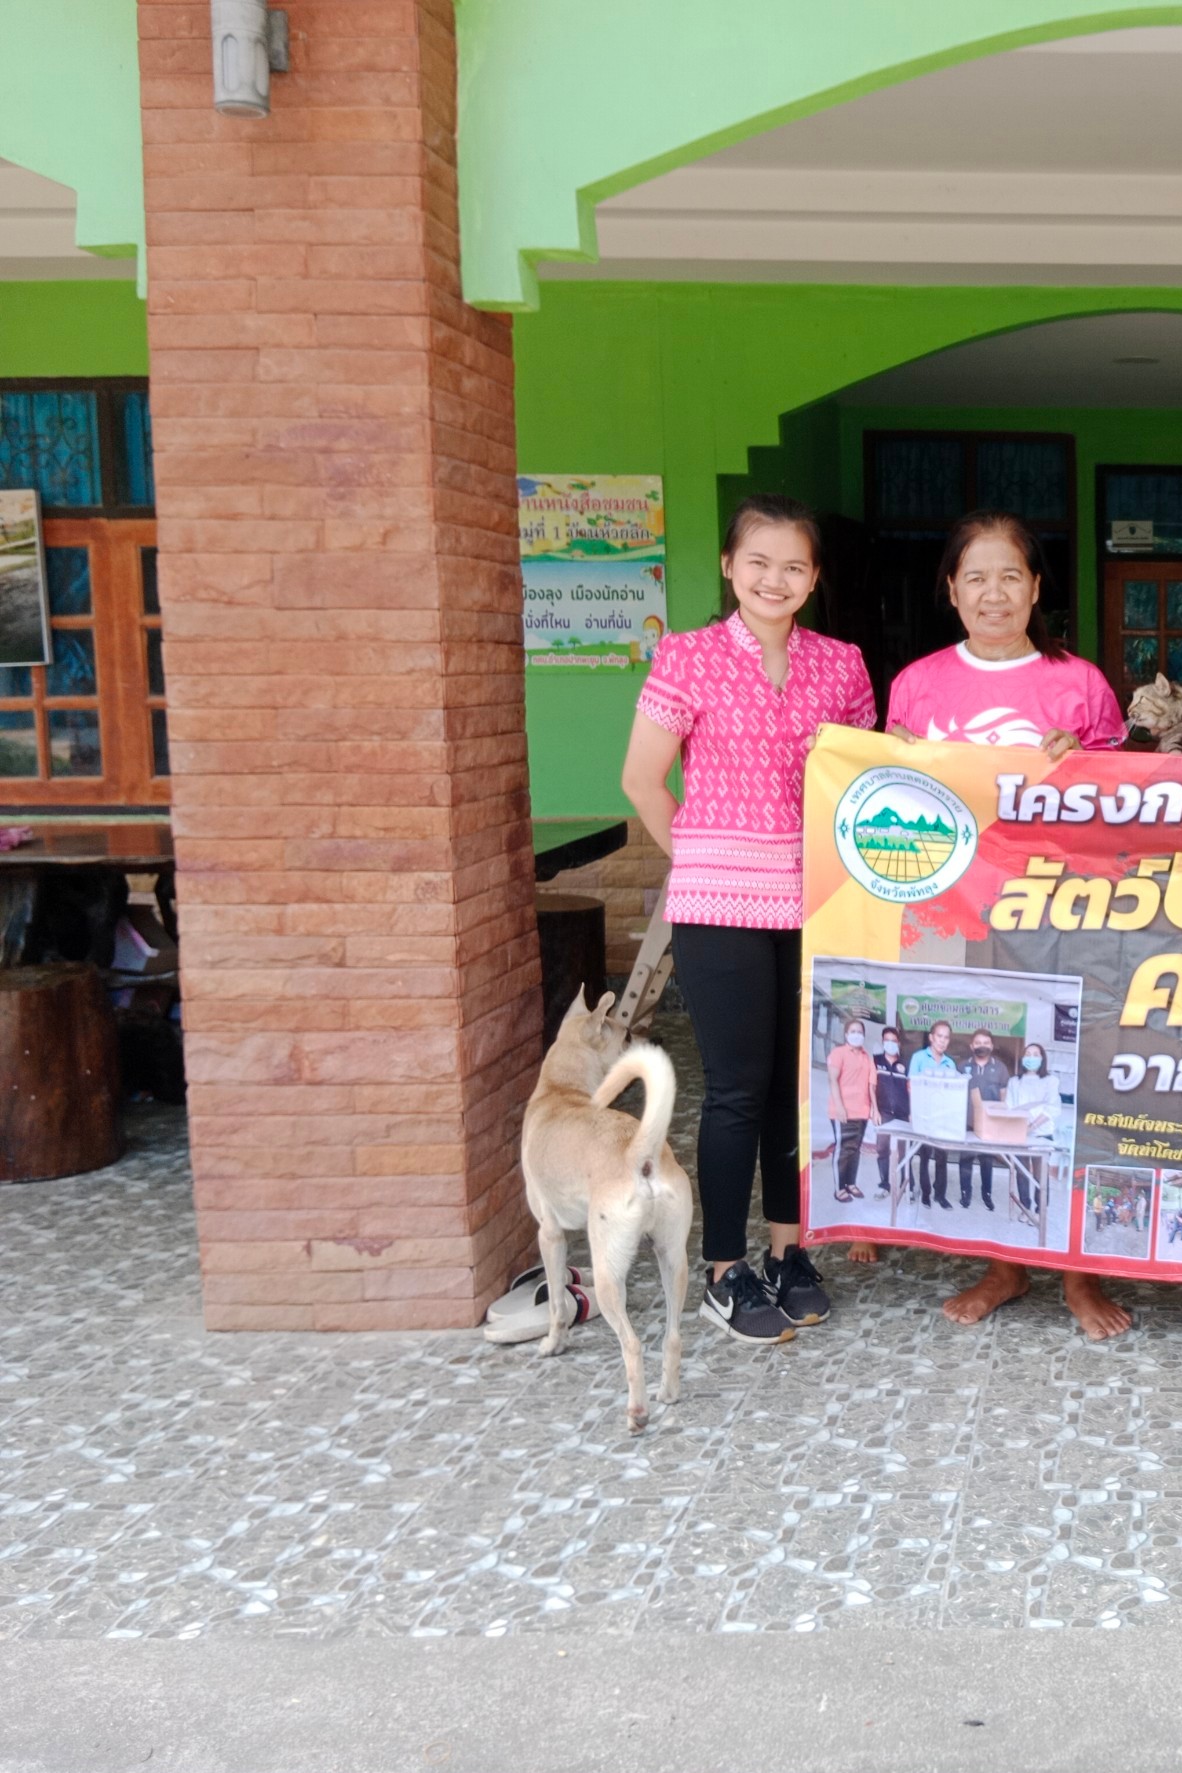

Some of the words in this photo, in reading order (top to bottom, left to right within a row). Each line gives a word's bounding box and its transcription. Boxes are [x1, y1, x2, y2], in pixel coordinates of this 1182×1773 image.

[522, 516, 545, 545] มู่ที่
[554, 526, 559, 539] 1
[571, 584, 644, 601] เมืองนักอ่าน
[525, 609, 570, 629] นั่งที่ไหน
[585, 609, 632, 629] อ่านที่นั่น
[850, 769, 963, 814] เทศบาลตำบลดอนทราย
[870, 878, 939, 898] จังหวัดพัทลุง
